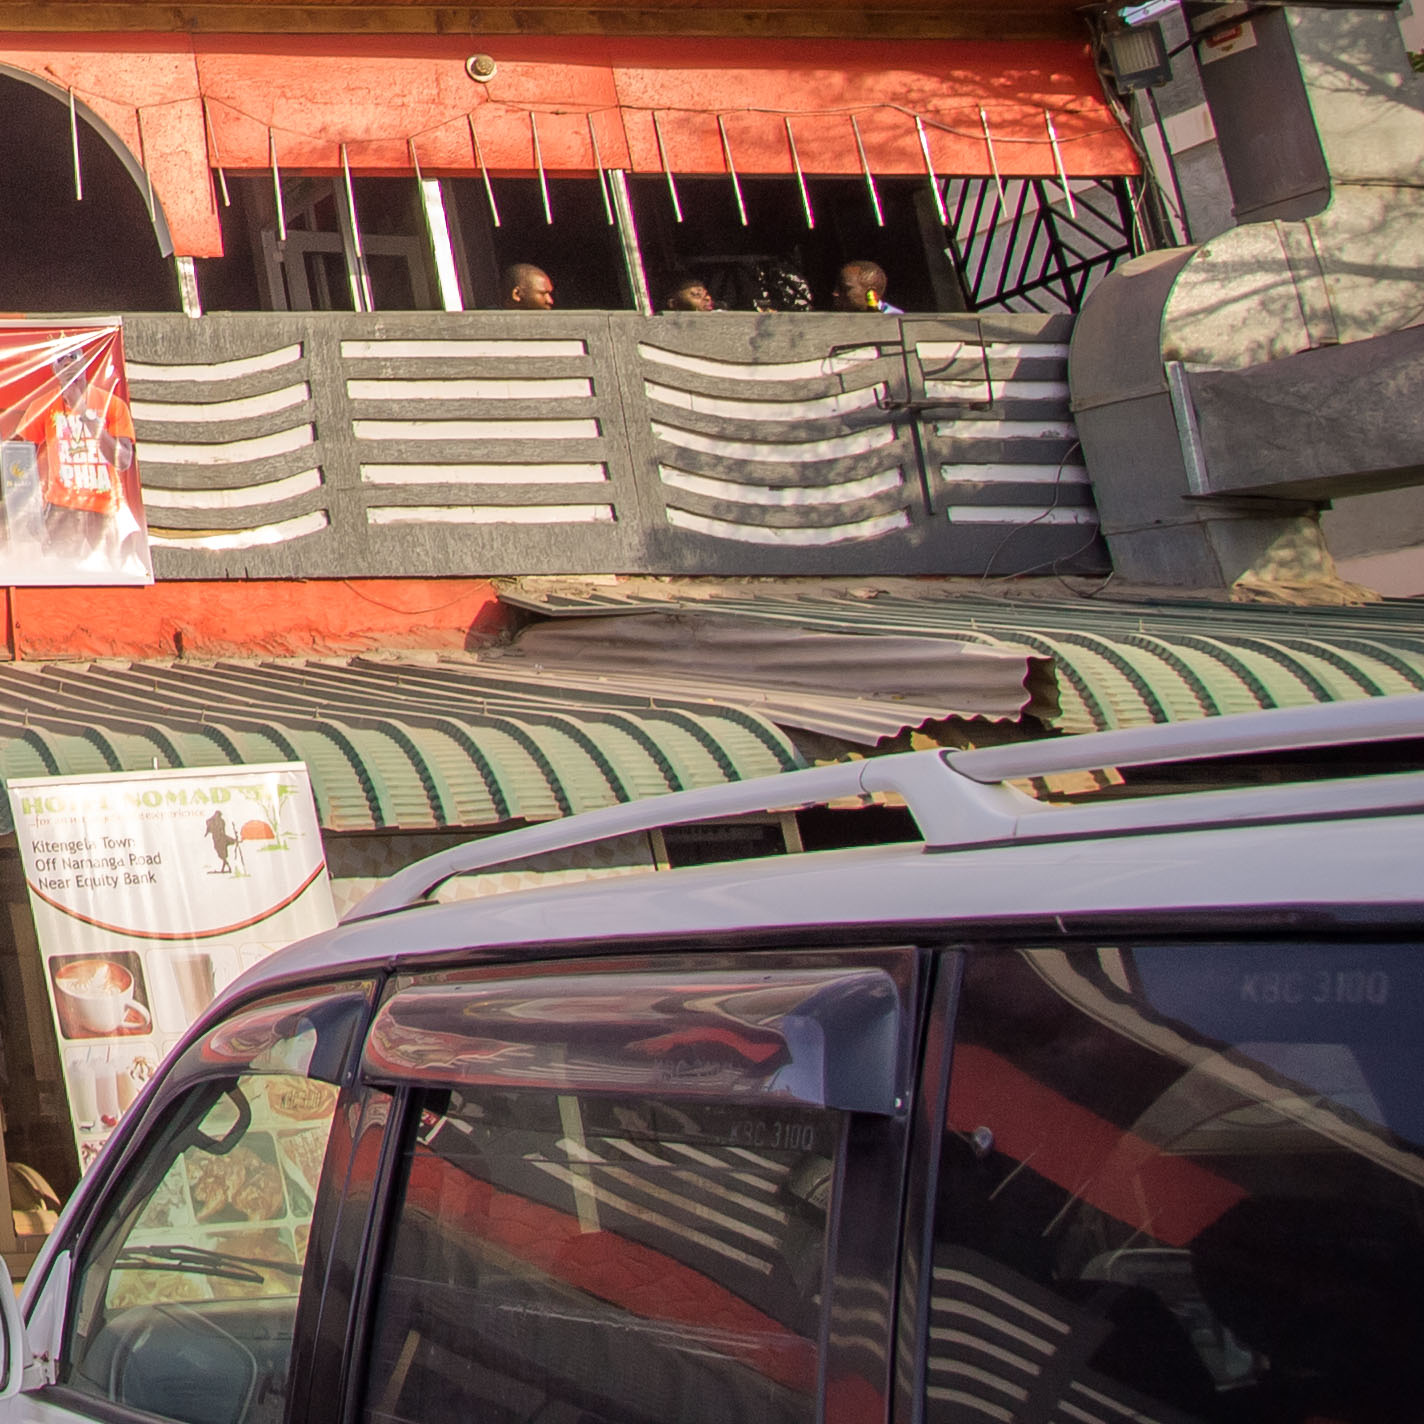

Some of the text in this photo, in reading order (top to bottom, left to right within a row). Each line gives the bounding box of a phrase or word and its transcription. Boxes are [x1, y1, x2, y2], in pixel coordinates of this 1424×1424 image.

[35, 858, 57, 872] Off
[129, 852, 162, 866] Road
[39, 870, 157, 891] Near Equity Bank
